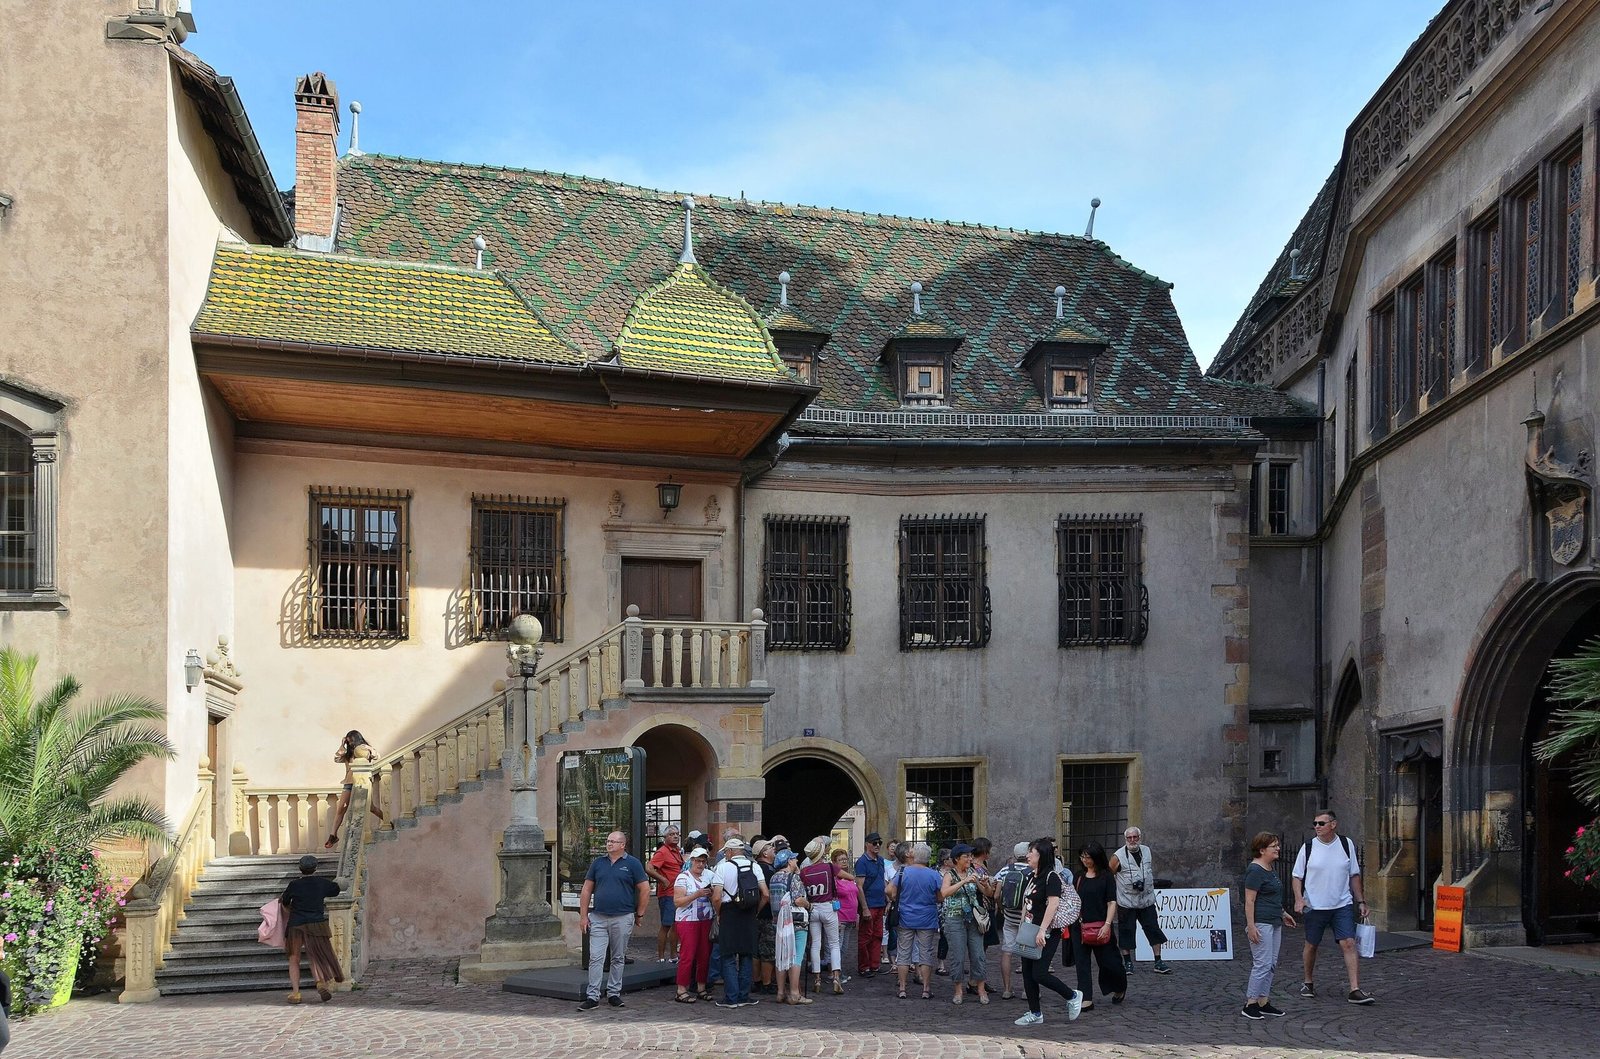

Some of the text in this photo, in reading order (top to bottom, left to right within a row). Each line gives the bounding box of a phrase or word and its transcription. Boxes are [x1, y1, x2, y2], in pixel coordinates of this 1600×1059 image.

[604, 754, 630, 764] COLMAR
[603, 765, 631, 780] JAZZ
[604, 782, 630, 791] FESTIVAL
[1158, 914, 1215, 930] TISANALE
[1186, 937, 1206, 949] libre
